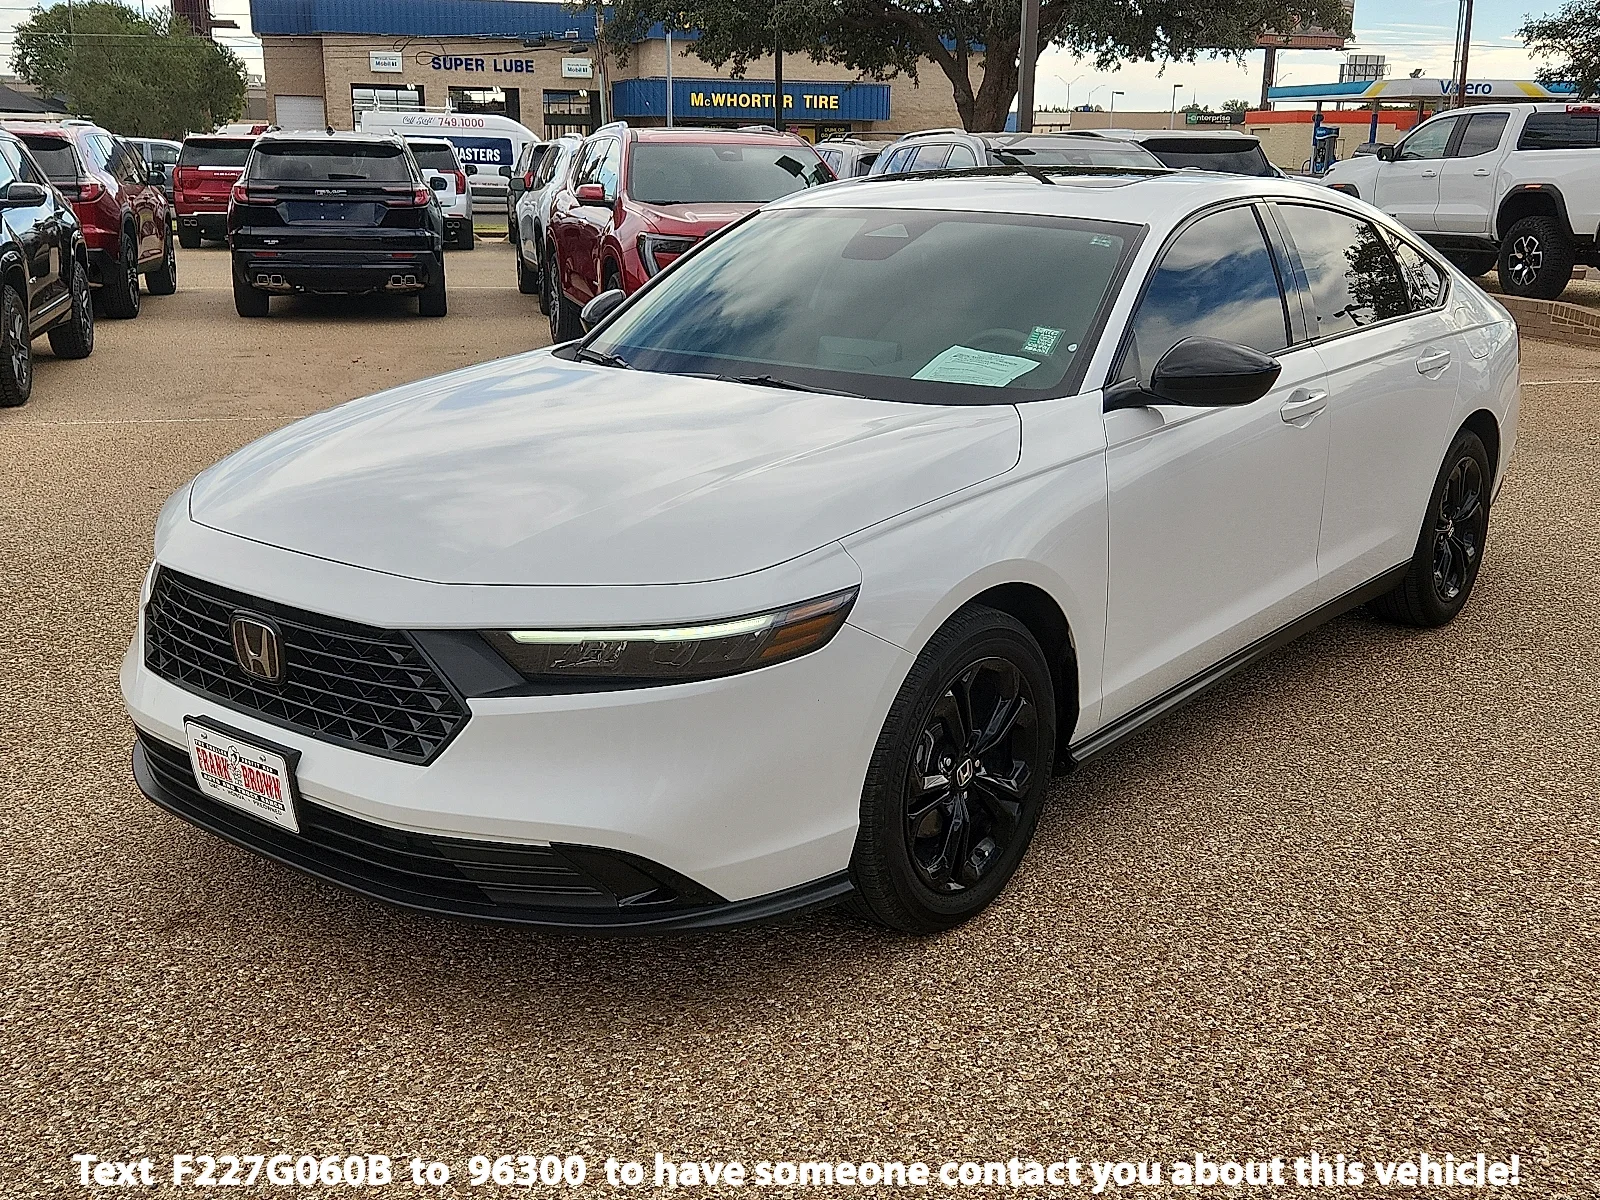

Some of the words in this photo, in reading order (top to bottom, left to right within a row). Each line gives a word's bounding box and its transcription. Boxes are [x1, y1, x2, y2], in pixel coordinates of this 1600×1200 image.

[431, 56, 485, 72] SUPER
[493, 58, 535, 74] LUBE
[1440, 80, 1492, 95] Vaero
[803, 94, 839, 109] TIRE
[438, 117, 485, 128] 749.1000
[195, 746, 232, 783] FRANK
[241, 764, 283, 803] BROWN
